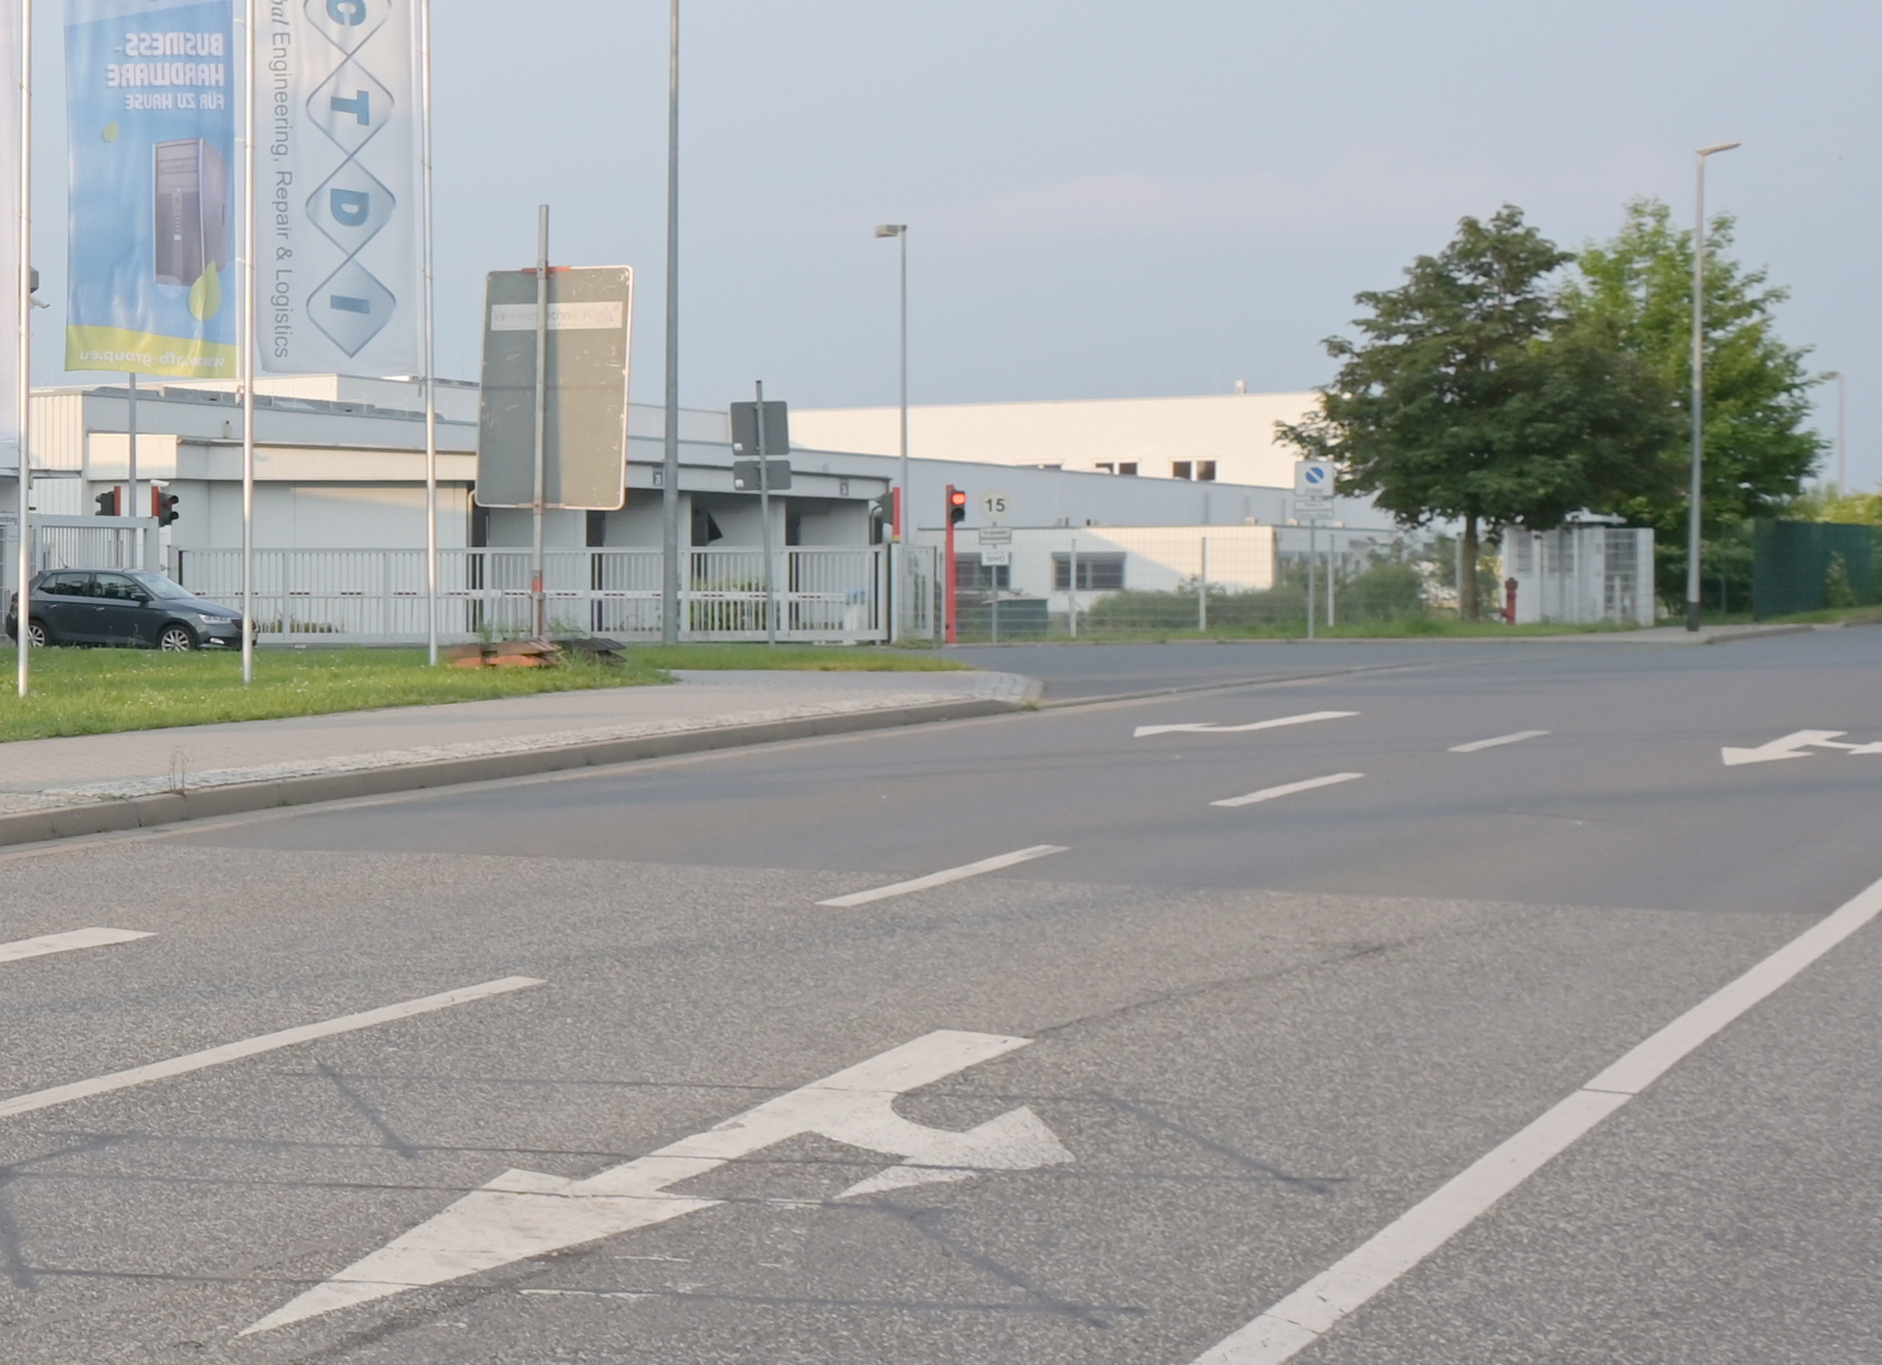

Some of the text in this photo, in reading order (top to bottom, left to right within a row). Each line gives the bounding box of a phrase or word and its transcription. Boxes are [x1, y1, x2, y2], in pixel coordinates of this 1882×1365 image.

[268, 32, 293, 162] Engineering,
[271, 171, 293, 240] Repair
[275, 246, 293, 261] &
[270, 269, 294, 358] Logistics
[986, 498, 1005, 512] 15
